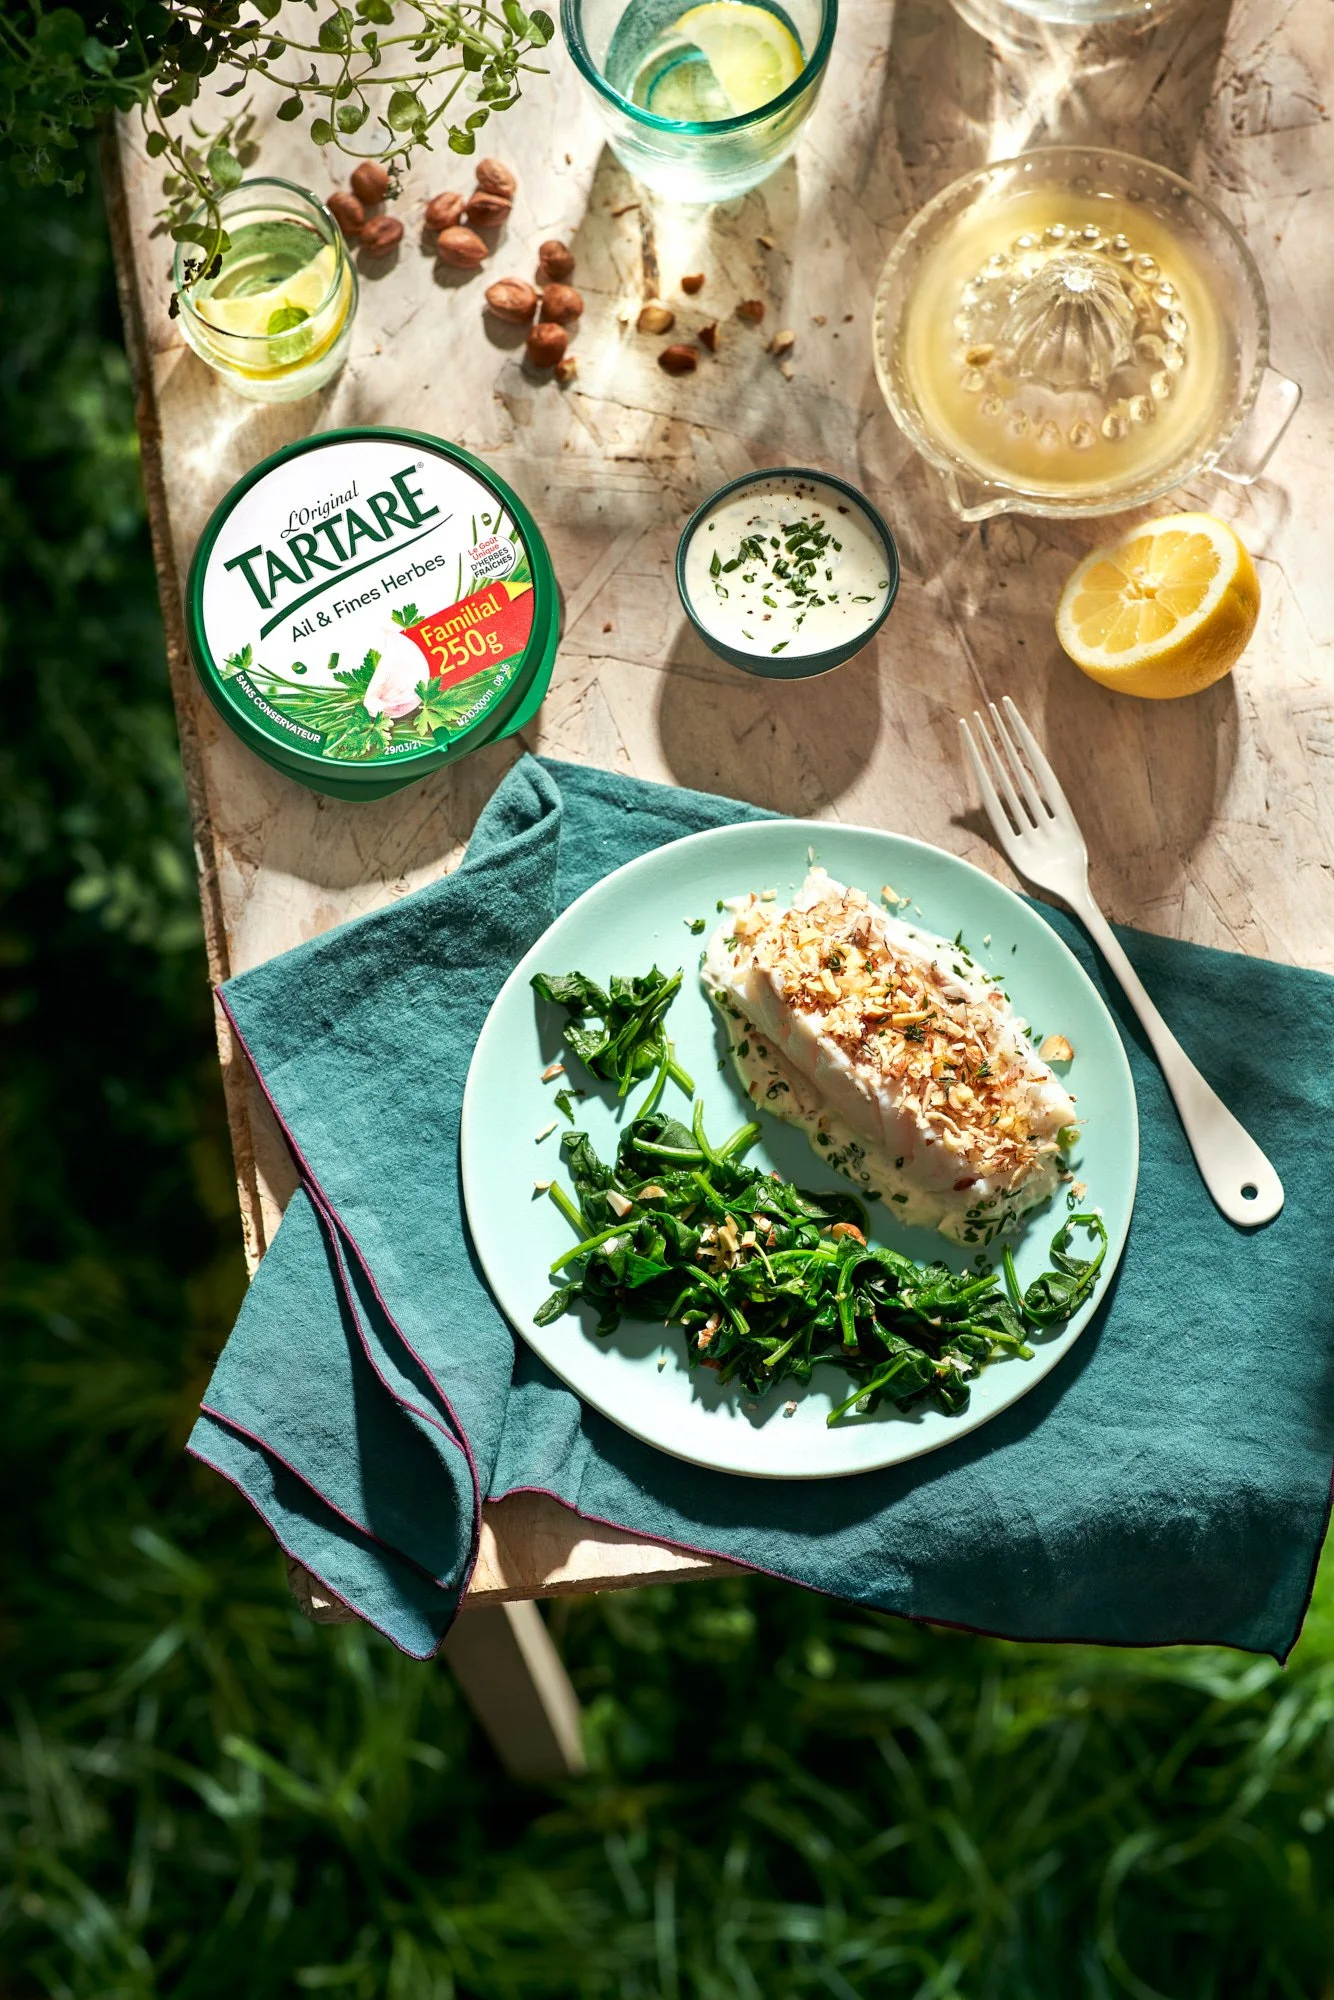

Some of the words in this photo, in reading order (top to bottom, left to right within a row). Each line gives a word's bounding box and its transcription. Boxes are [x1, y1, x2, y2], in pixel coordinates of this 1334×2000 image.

[223, 464, 440, 609] TARTARE
[468, 545, 479, 556] Le
[479, 536, 498, 550] Goût
[472, 544, 500, 561] Unique
[470, 547, 509, 571] D'HERBES
[474, 554, 513, 578] FRAÎCHES
[292, 618, 316, 643] Ail
[316, 611, 333, 627] &
[333, 587, 381, 618] Fines
[381, 554, 446, 594] Herbes
[420, 593, 502, 647] Familial
[431, 629, 504, 675] 250g
[236, 674, 257, 699] SANS
[253, 697, 321, 744] CONSERVATEUR
[384, 741, 422, 755] 29/03/21
